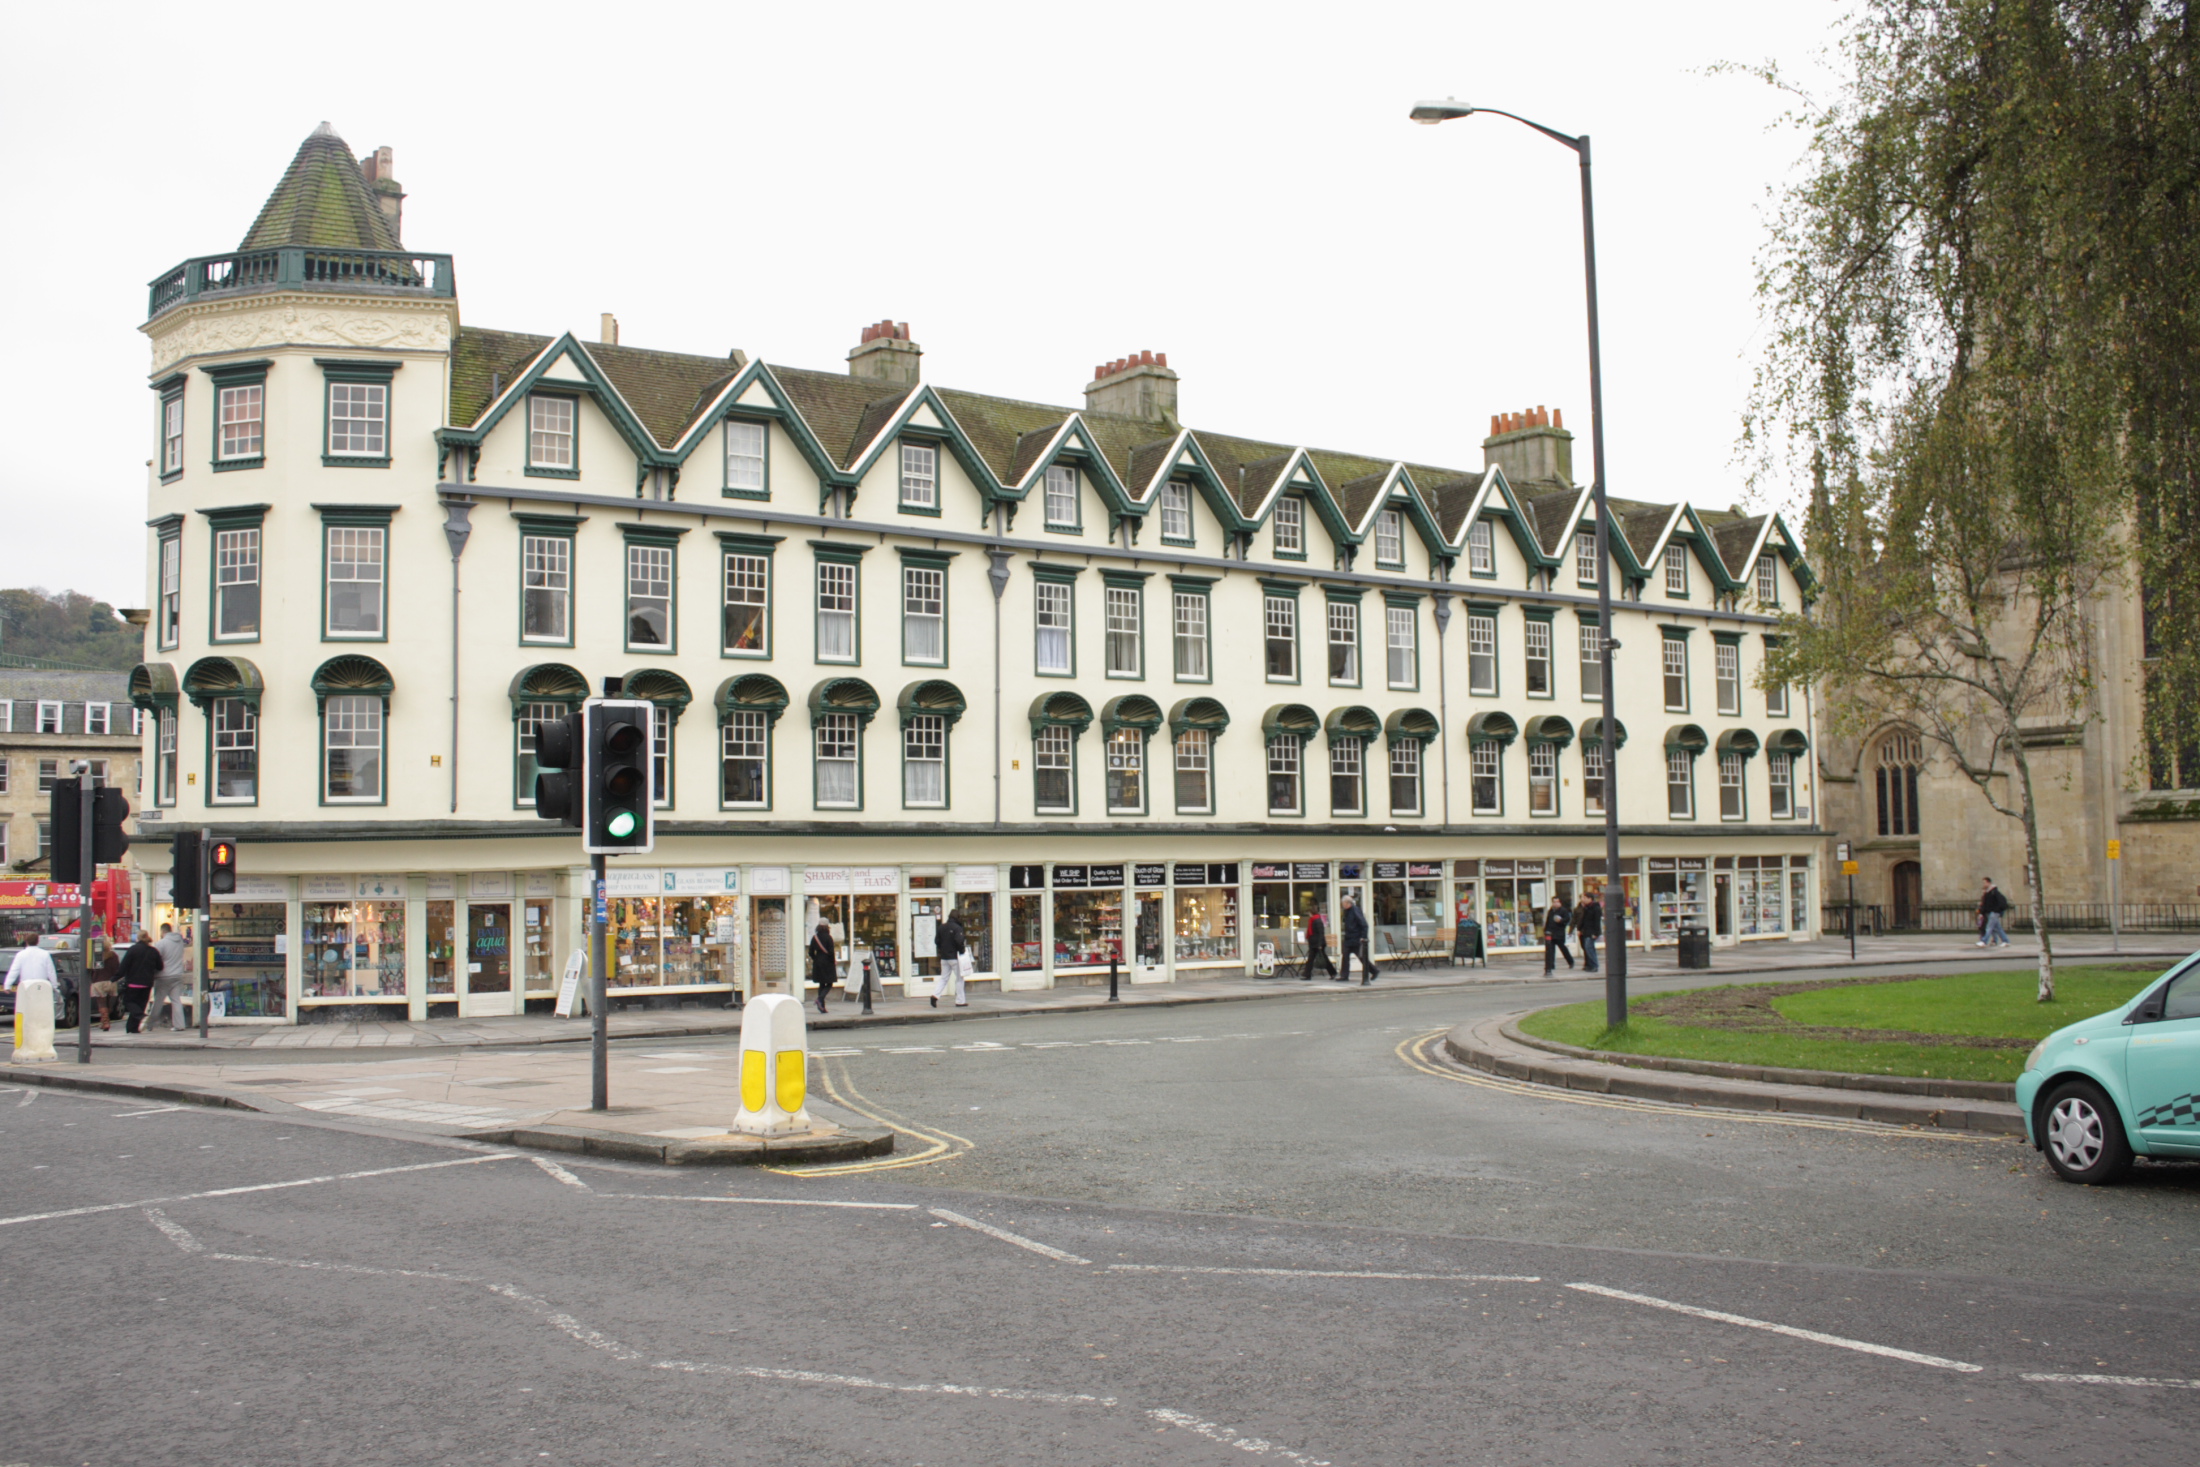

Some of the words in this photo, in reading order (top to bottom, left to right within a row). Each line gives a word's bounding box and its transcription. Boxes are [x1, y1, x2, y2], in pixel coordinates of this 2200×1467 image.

[804, 871, 842, 883] SHARPS
[854, 869, 871, 877] and
[864, 875, 892, 887] FLATS
[476, 936, 506, 951] aqua
